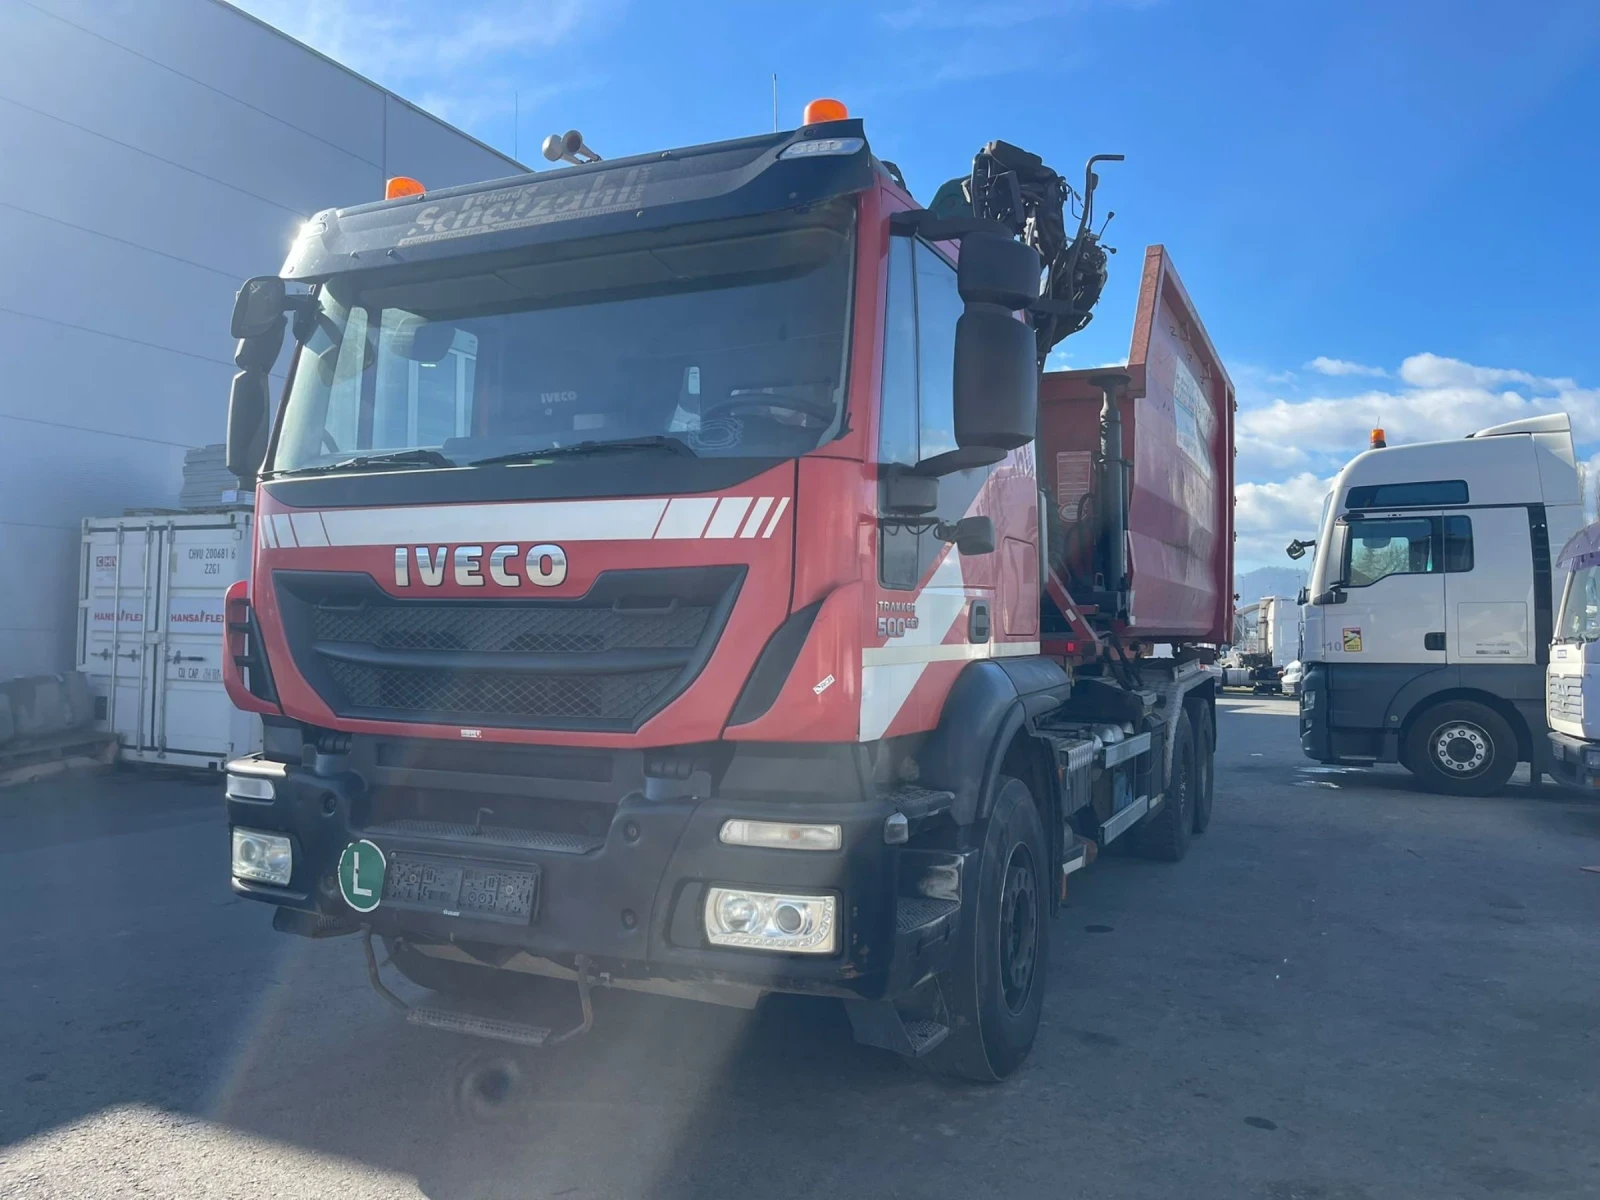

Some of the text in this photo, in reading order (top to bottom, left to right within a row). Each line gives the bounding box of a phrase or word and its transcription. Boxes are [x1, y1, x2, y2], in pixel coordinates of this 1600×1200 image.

[475, 188, 523, 206] Erhard
[540, 391, 577, 403] IVECO
[231, 549, 236, 559] 6
[394, 544, 568, 587] IVECO
[877, 617, 905, 638] 500
[353, 851, 372, 897] L
